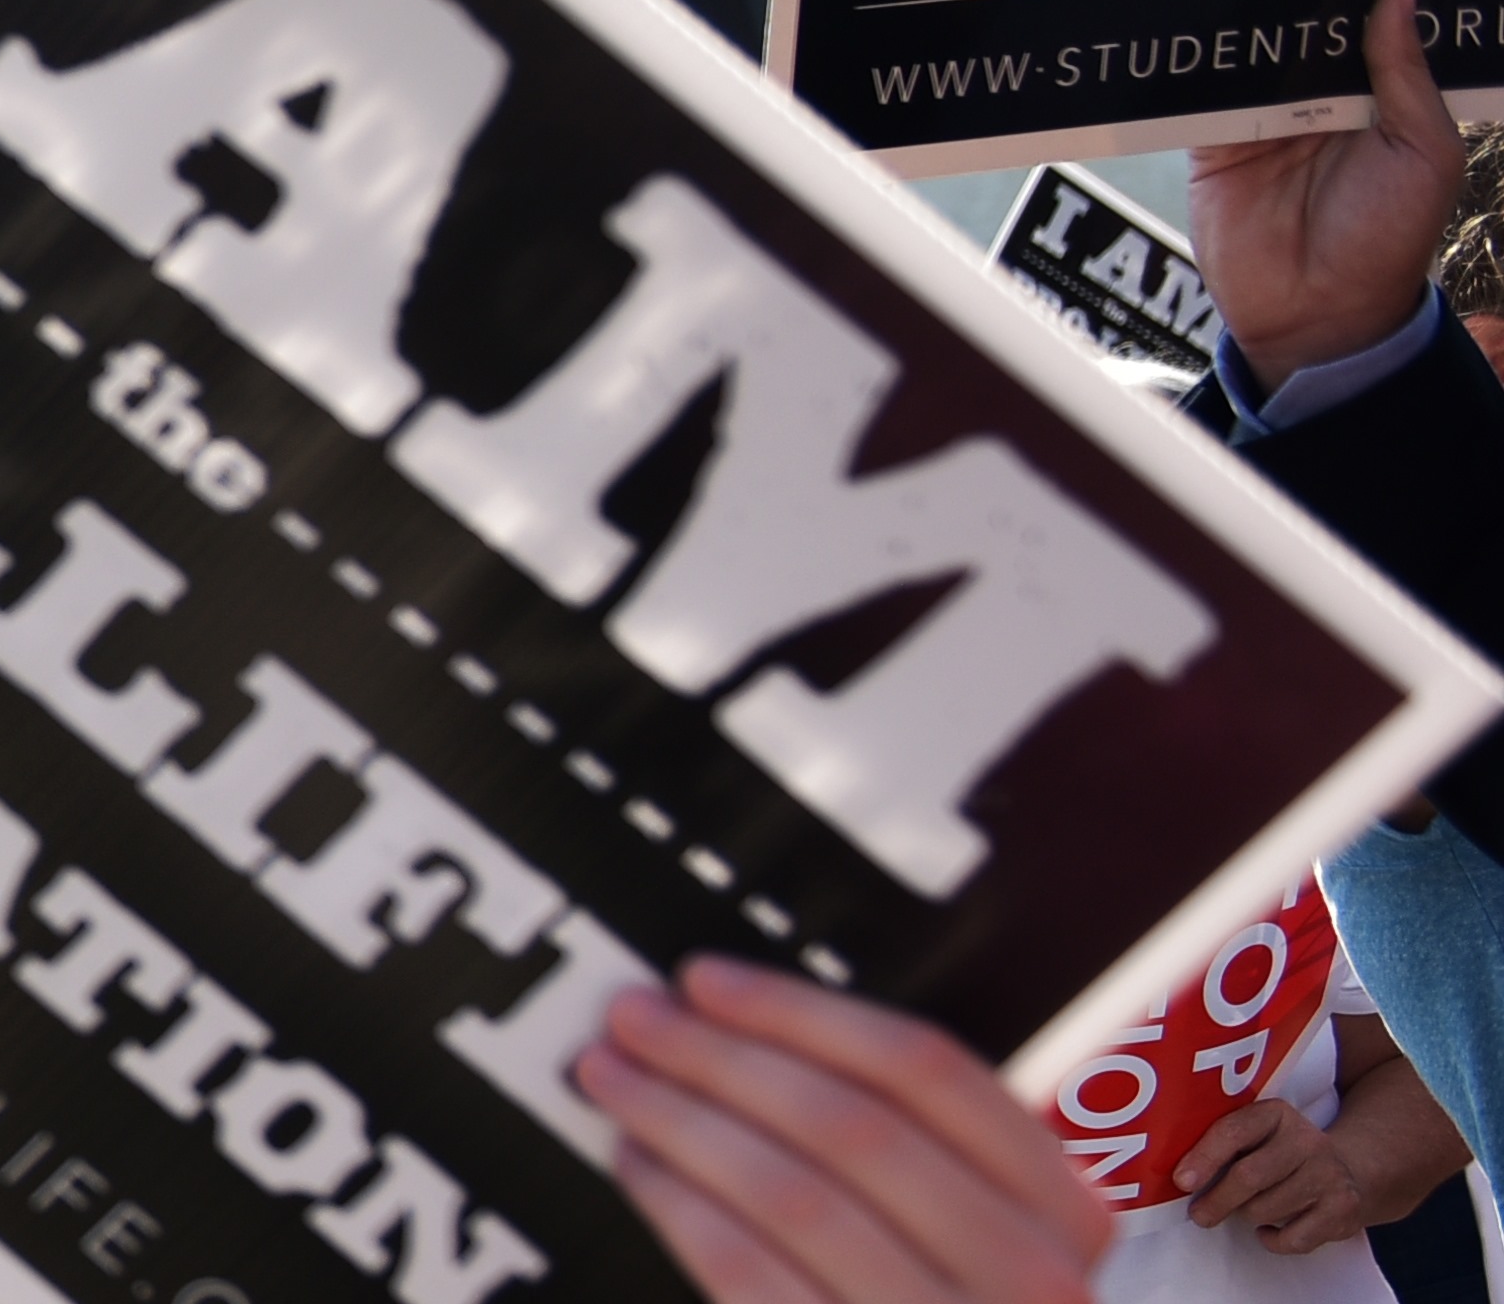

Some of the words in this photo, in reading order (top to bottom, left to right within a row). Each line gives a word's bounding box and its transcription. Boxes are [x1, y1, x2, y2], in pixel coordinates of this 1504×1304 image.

[1030, 181, 1091, 260] I
[1079, 226, 1226, 358] AM
[85, 336, 268, 518] the
